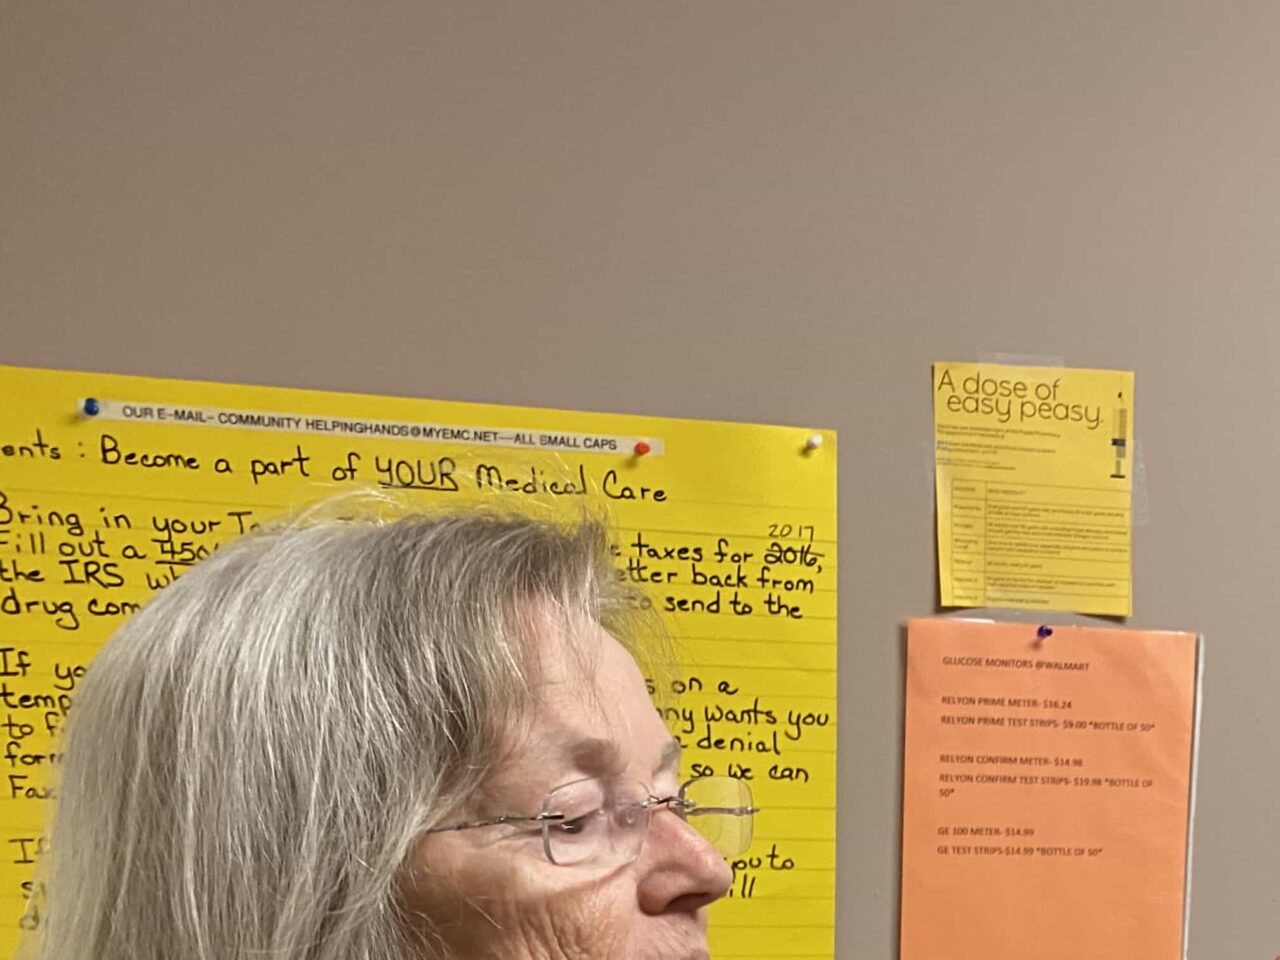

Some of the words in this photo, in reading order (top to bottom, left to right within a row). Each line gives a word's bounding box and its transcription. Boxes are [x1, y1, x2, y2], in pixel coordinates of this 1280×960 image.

[937, 369, 956, 392] A
[962, 372, 1027, 400] dose
[1034, 378, 1062, 401] of
[947, 392, 1012, 423] easy
[122, 405, 154, 420] OUR
[218, 412, 302, 430] COMMUNITY
[539, 434, 580, 449] SMALL
[583, 437, 618, 451] CAPS
[100, 434, 200, 470] Become
[214, 457, 233, 474] a
[250, 445, 311, 484] part
[332, 452, 361, 482] of
[374, 455, 459, 489] YOUR
[475, 463, 588, 495] Medical
[602, 470, 668, 502] Care
[99, 506, 132, 529] in
[151, 514, 221, 543] your
[768, 524, 815, 542] 2017
[58, 530, 110, 558] out
[121, 544, 147, 560] a
[630, 531, 704, 563] taxes
[713, 538, 754, 564] for
[58, 559, 125, 589] IRS
[615, 557, 679, 583] etter
[691, 562, 749, 589] back
[756, 566, 815, 594] from
[1, 586, 80, 630] drug
[664, 589, 721, 614] send
[729, 591, 753, 616] to
[763, 592, 804, 619] the
[0, 646, 32, 678] If
[942, 655, 984, 667] GLUCOSE
[985, 657, 1033, 669] MONITORS
[1034, 660, 1090, 672] @WALMART
[671, 676, 703, 695] on
[717, 679, 740, 696] a
[941, 696, 976, 706] RELYON
[977, 697, 1005, 707] PRIME
[2, 713, 34, 740] to
[704, 697, 778, 725] wants
[784, 711, 830, 741] you
[941, 716, 976, 726] RELYON
[977, 717, 1005, 727] PRIME
[1008, 717, 1027, 728] TEST
[1126, 722, 1138, 732] OF
[696, 722, 782, 756] denial
[690, 763, 714, 780] so
[727, 763, 755, 781] we
[768, 763, 809, 784] can
[939, 754, 975, 764] RELYON
[976, 755, 1018, 765] CONFIRM
[939, 773, 974, 784] RELYON
[975, 774, 1017, 785] CONFIRM
[1019, 775, 1039, 785] TEST
[1142, 779, 1153, 788] OF
[937, 826, 950, 837] GE
[952, 826, 969, 837] 100
[766, 844, 796, 870] to
[937, 845, 949, 856] GE
[951, 845, 972, 856] TEST
[1074, 847, 1086, 857] OF
